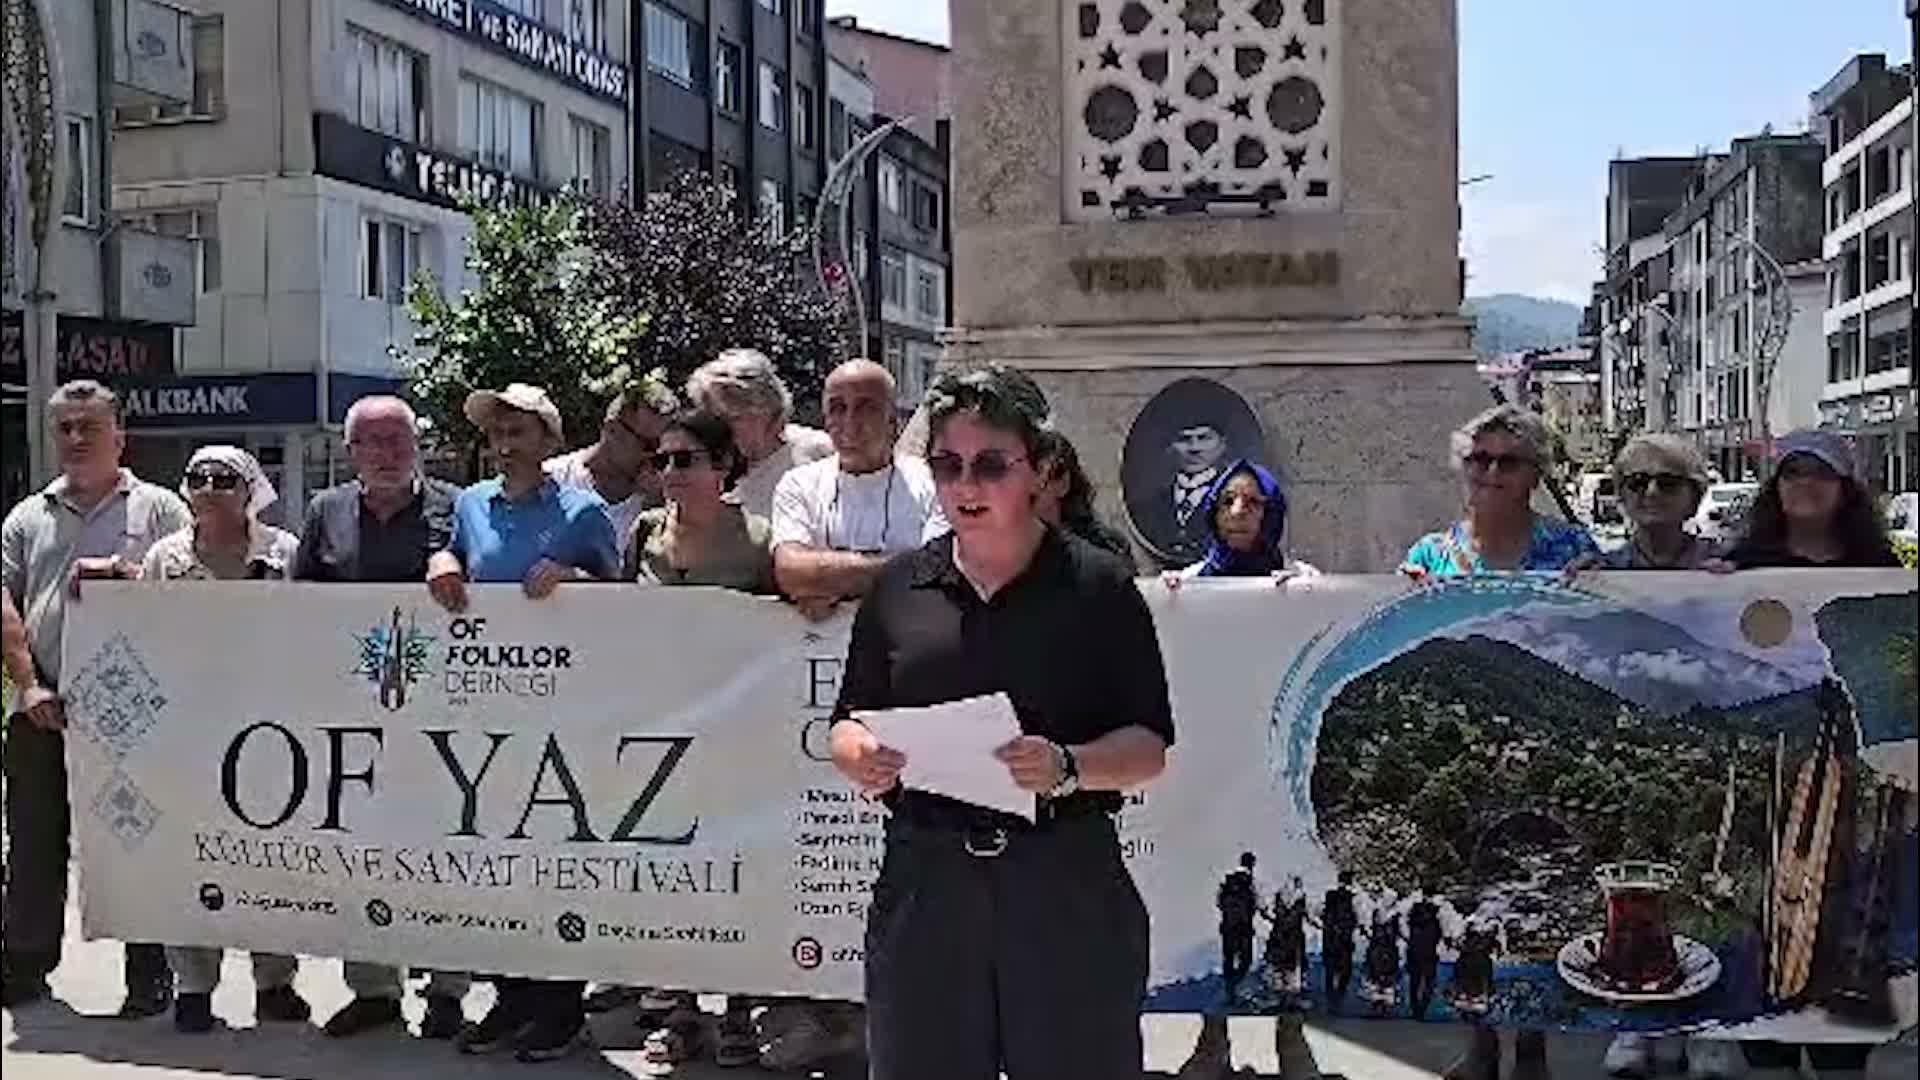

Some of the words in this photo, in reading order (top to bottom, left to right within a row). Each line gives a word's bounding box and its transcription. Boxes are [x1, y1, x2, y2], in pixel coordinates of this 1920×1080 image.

[122, 386, 250, 415] ALKBANK
[449, 618, 486, 640] OF
[445, 646, 571, 668] FOLKLOR
[220, 721, 384, 832] OF
[421, 730, 700, 845] YAZ
[332, 843, 384, 880] VE
[394, 847, 521, 887] SANAT
[531, 849, 743, 894] FESTİVALİ
